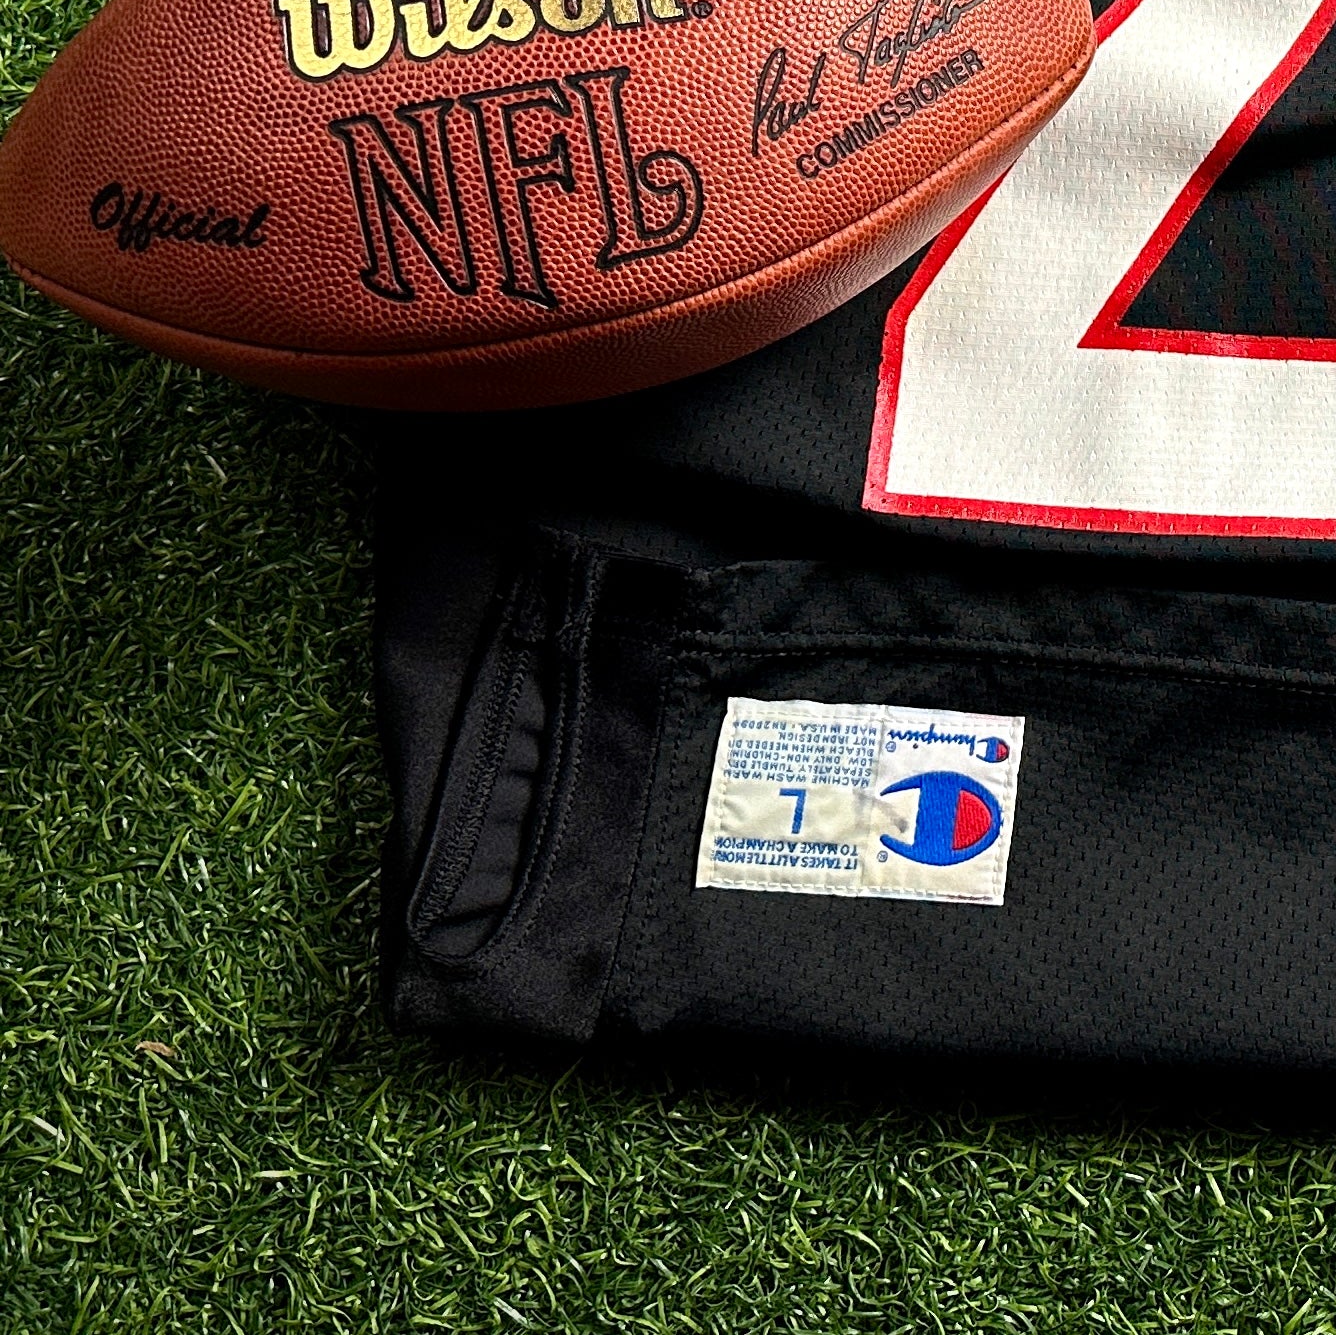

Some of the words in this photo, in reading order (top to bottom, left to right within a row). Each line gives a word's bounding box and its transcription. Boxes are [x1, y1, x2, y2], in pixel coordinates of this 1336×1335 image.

[796, 48, 986, 180] COMMISSIONER
[328, 66, 705, 310] NFL
[87, 180, 271, 252] Official
[830, 724, 841, 734] IN
[845, 725, 877, 736] MADE
[822, 735, 849, 745] IRON
[853, 736, 876, 747] NOT
[792, 743, 825, 754] WHEN
[829, 746, 875, 758] BLEACH
[813, 755, 840, 765] ONLY
[750, 761, 794, 773] TUMBLE
[767, 773, 807, 783] WASH
[811, 775, 870, 787] MACHINE
[779, 788, 807, 834] L
[787, 841, 798, 853] A
[800, 841, 839, 855] MAKE
[840, 844, 859, 856] TO
[746, 852, 789, 866] LITTLE
[800, 856, 841, 870] TAKES
[844, 858, 858, 870] IT
